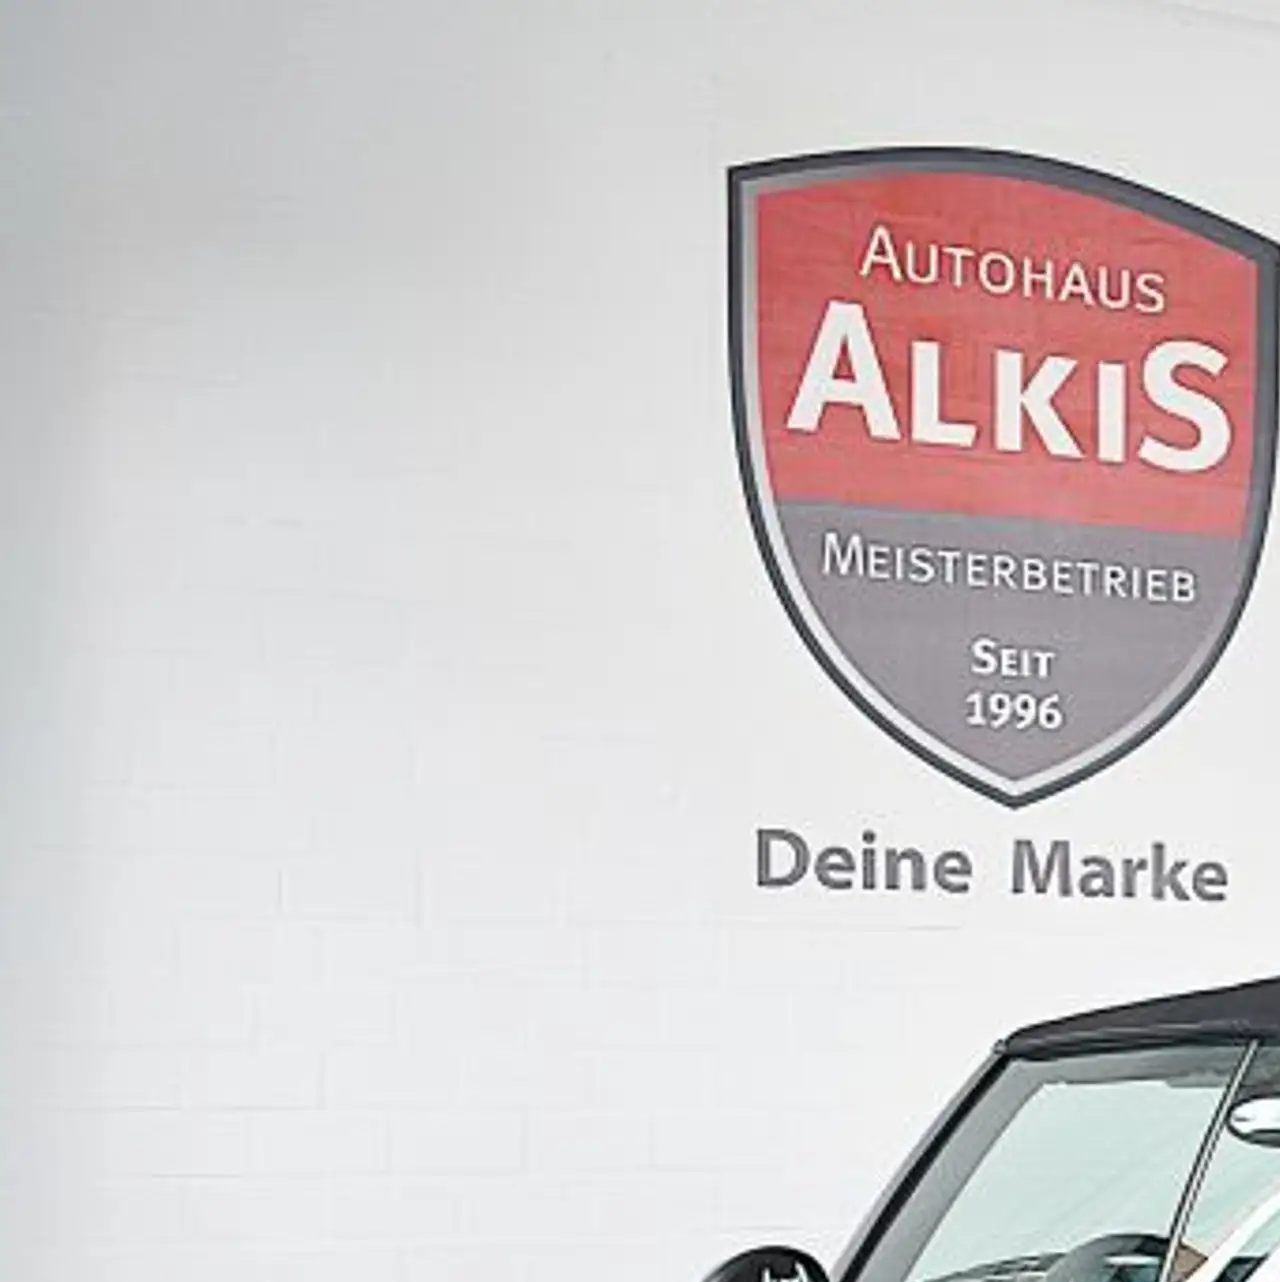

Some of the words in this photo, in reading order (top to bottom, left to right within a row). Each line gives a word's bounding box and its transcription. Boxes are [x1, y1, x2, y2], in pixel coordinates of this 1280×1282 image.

[860, 225, 1166, 313] AUTOHAUS
[821, 531, 1197, 603] MEISTERBETRIEB
[971, 637, 1056, 678] SEIT
[964, 692, 1063, 730] 1996
[755, 827, 974, 894] Deine
[1010, 838, 1229, 902] Marke
